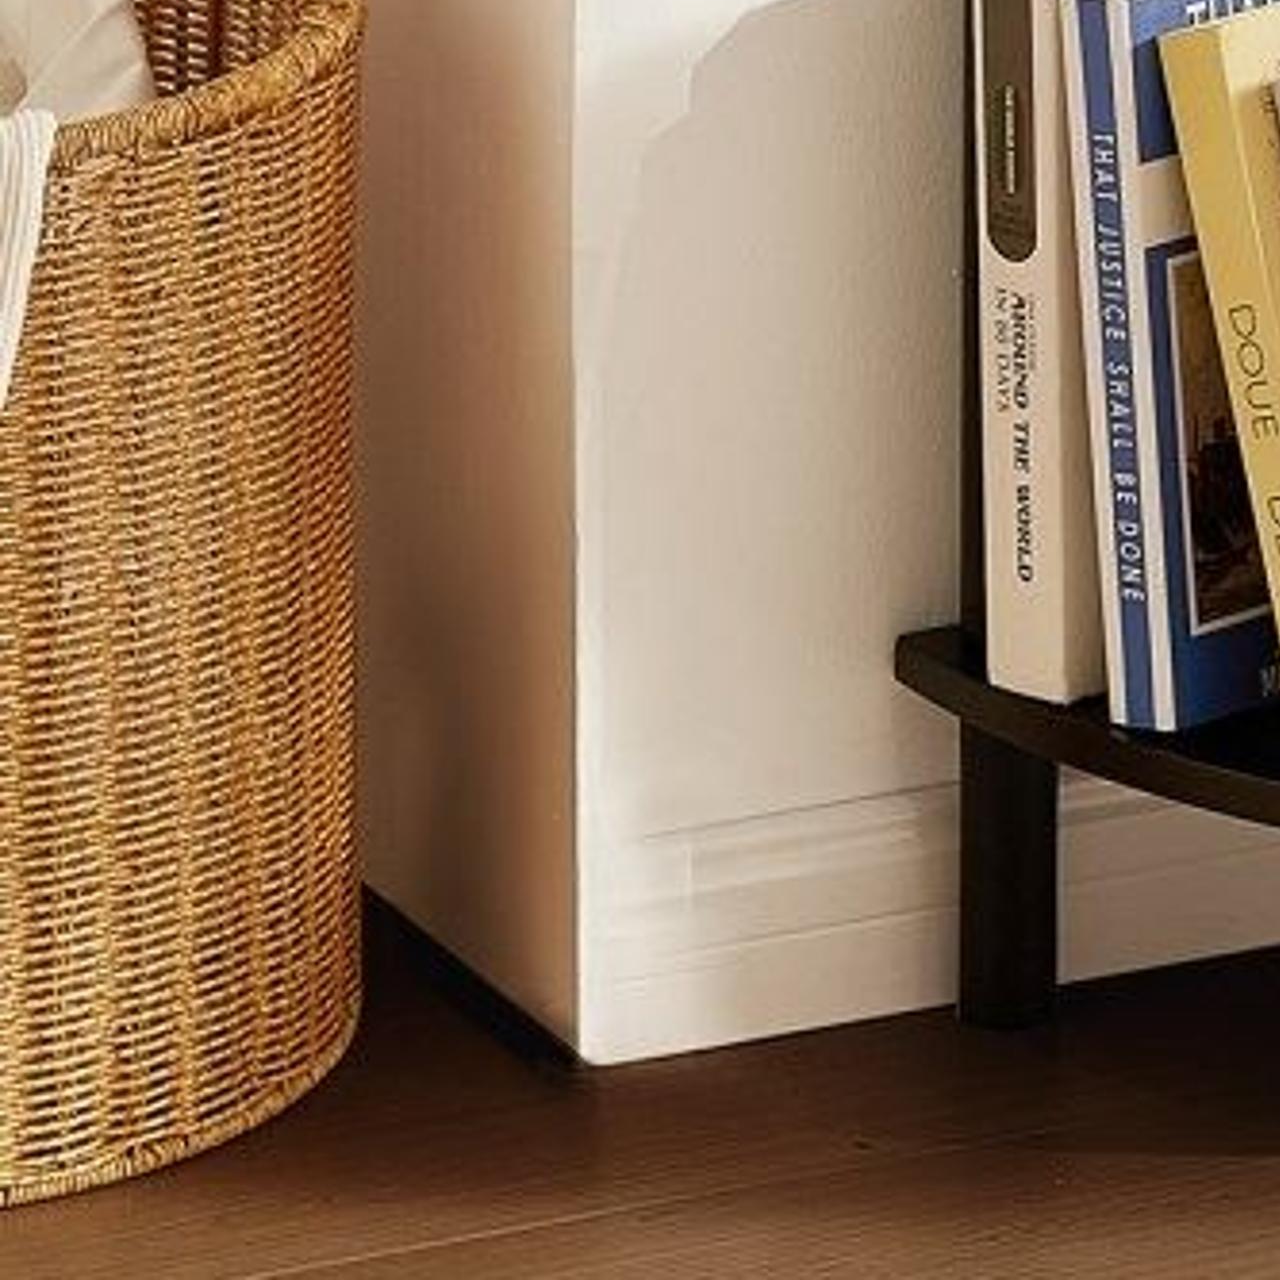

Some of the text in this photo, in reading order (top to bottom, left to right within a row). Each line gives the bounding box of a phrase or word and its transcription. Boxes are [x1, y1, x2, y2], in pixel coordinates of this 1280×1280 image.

[1010, 292, 1034, 583] AROUND THE WORLD
[1094, 134, 1145, 602] THAT JUSTICE SHALL BE DONE
